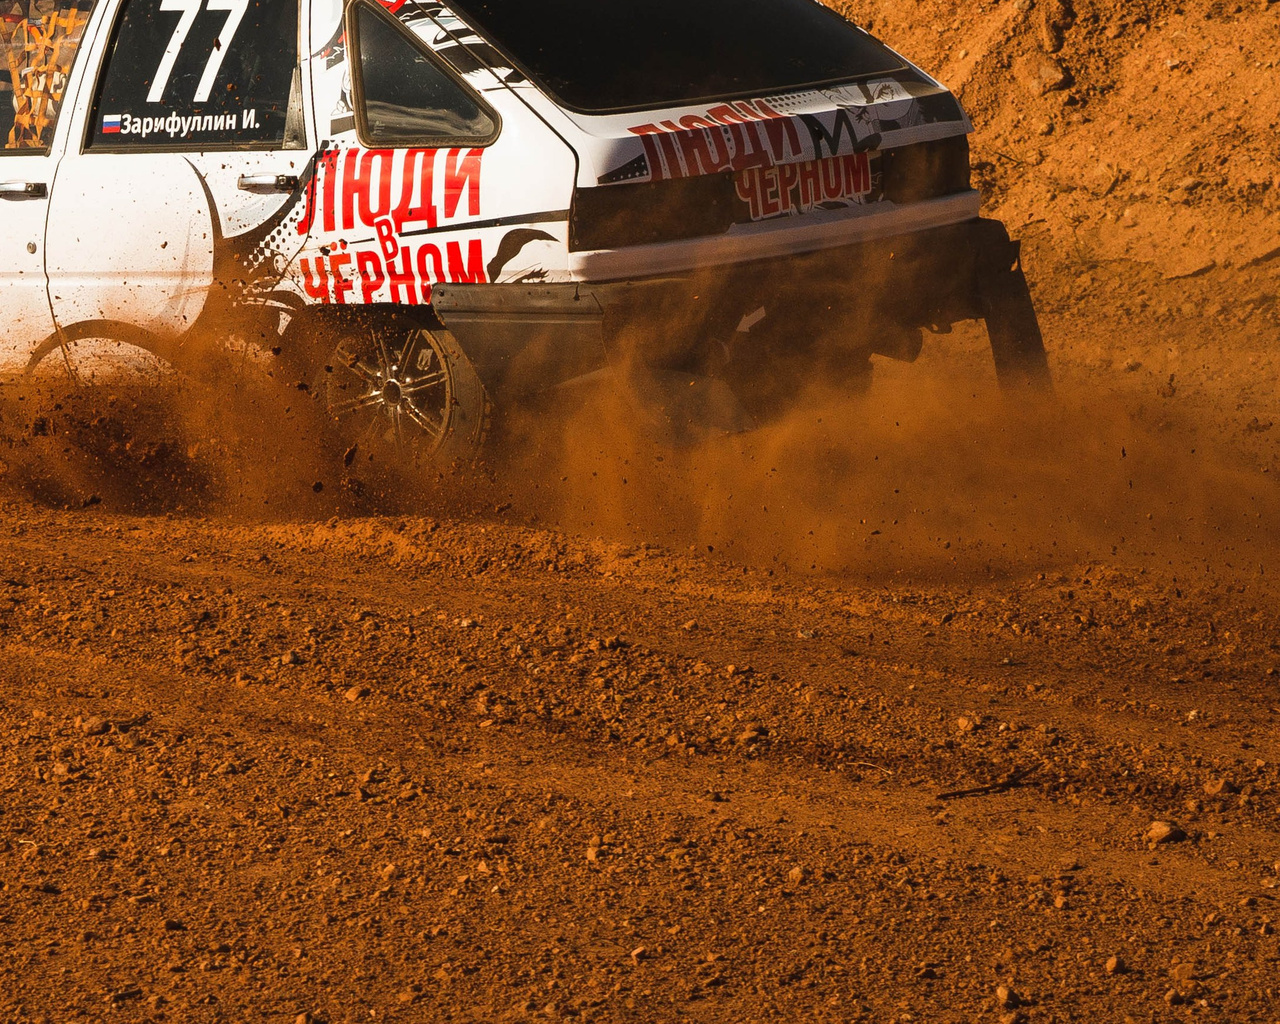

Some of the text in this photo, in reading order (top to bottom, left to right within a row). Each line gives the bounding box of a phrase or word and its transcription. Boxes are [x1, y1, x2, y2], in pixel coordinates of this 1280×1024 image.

[120, 108, 260, 138] Зарифуллин И.
[626, 98, 802, 183] ЛЮДИ
[297, 148, 485, 236] ЛЮДИ
[374, 218, 399, 263] В
